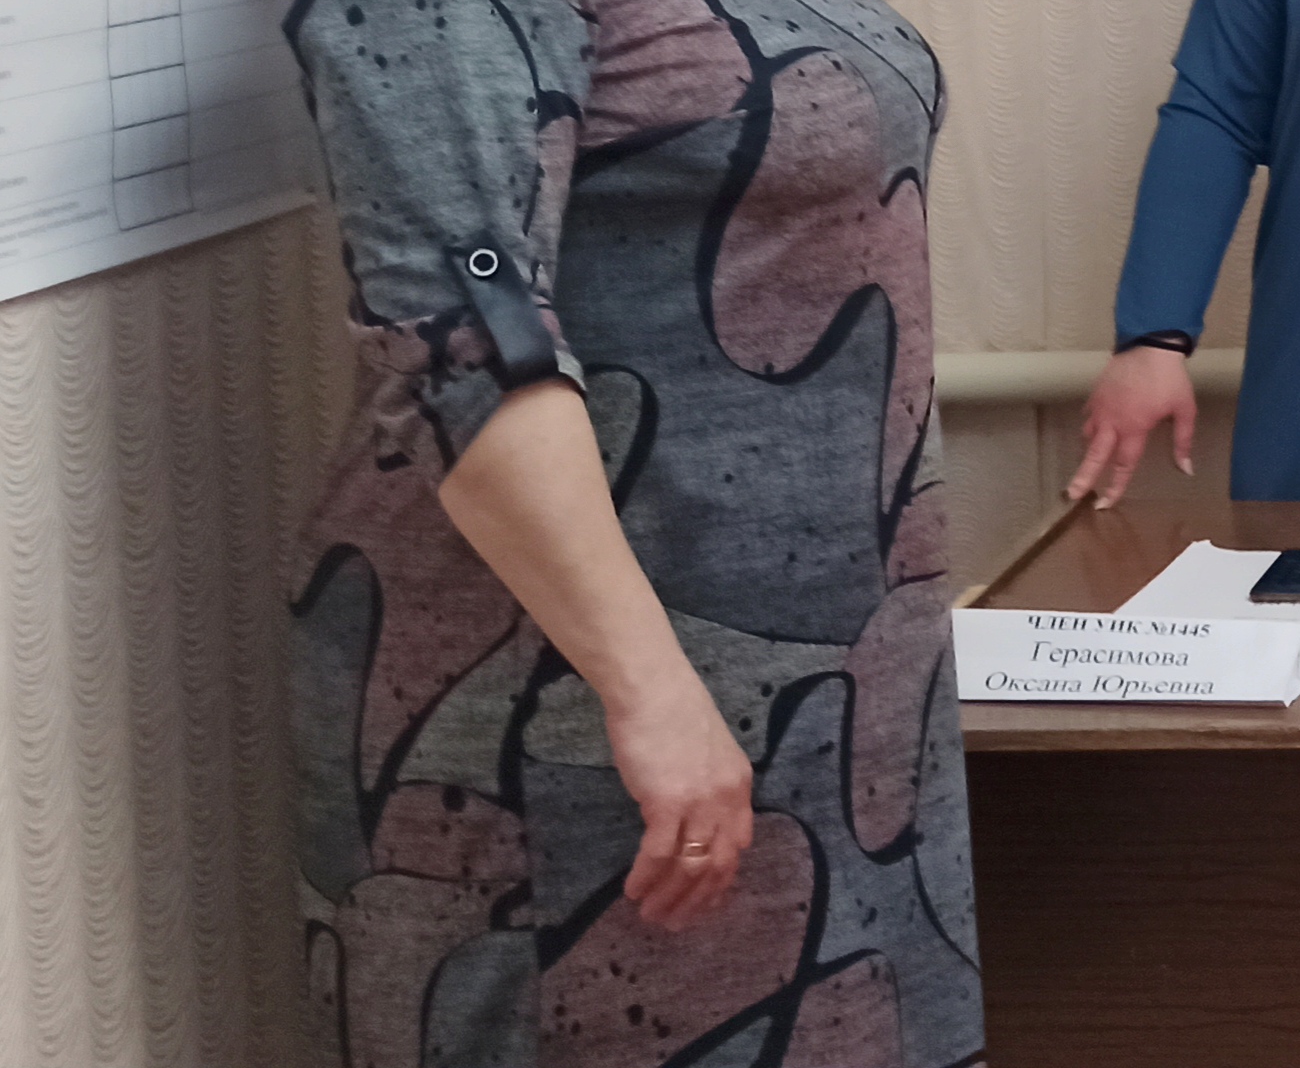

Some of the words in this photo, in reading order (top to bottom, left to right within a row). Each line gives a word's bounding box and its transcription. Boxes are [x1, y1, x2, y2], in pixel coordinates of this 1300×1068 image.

[1027, 615, 1087, 631] ЧЛЕН
[1095, 618, 1140, 634] УИК
[1143, 621, 1213, 638] №1445
[1029, 640, 1190, 667] Герасимова
[984, 671, 1082, 694] Оксана
[1091, 675, 1215, 699] Юрьевна
